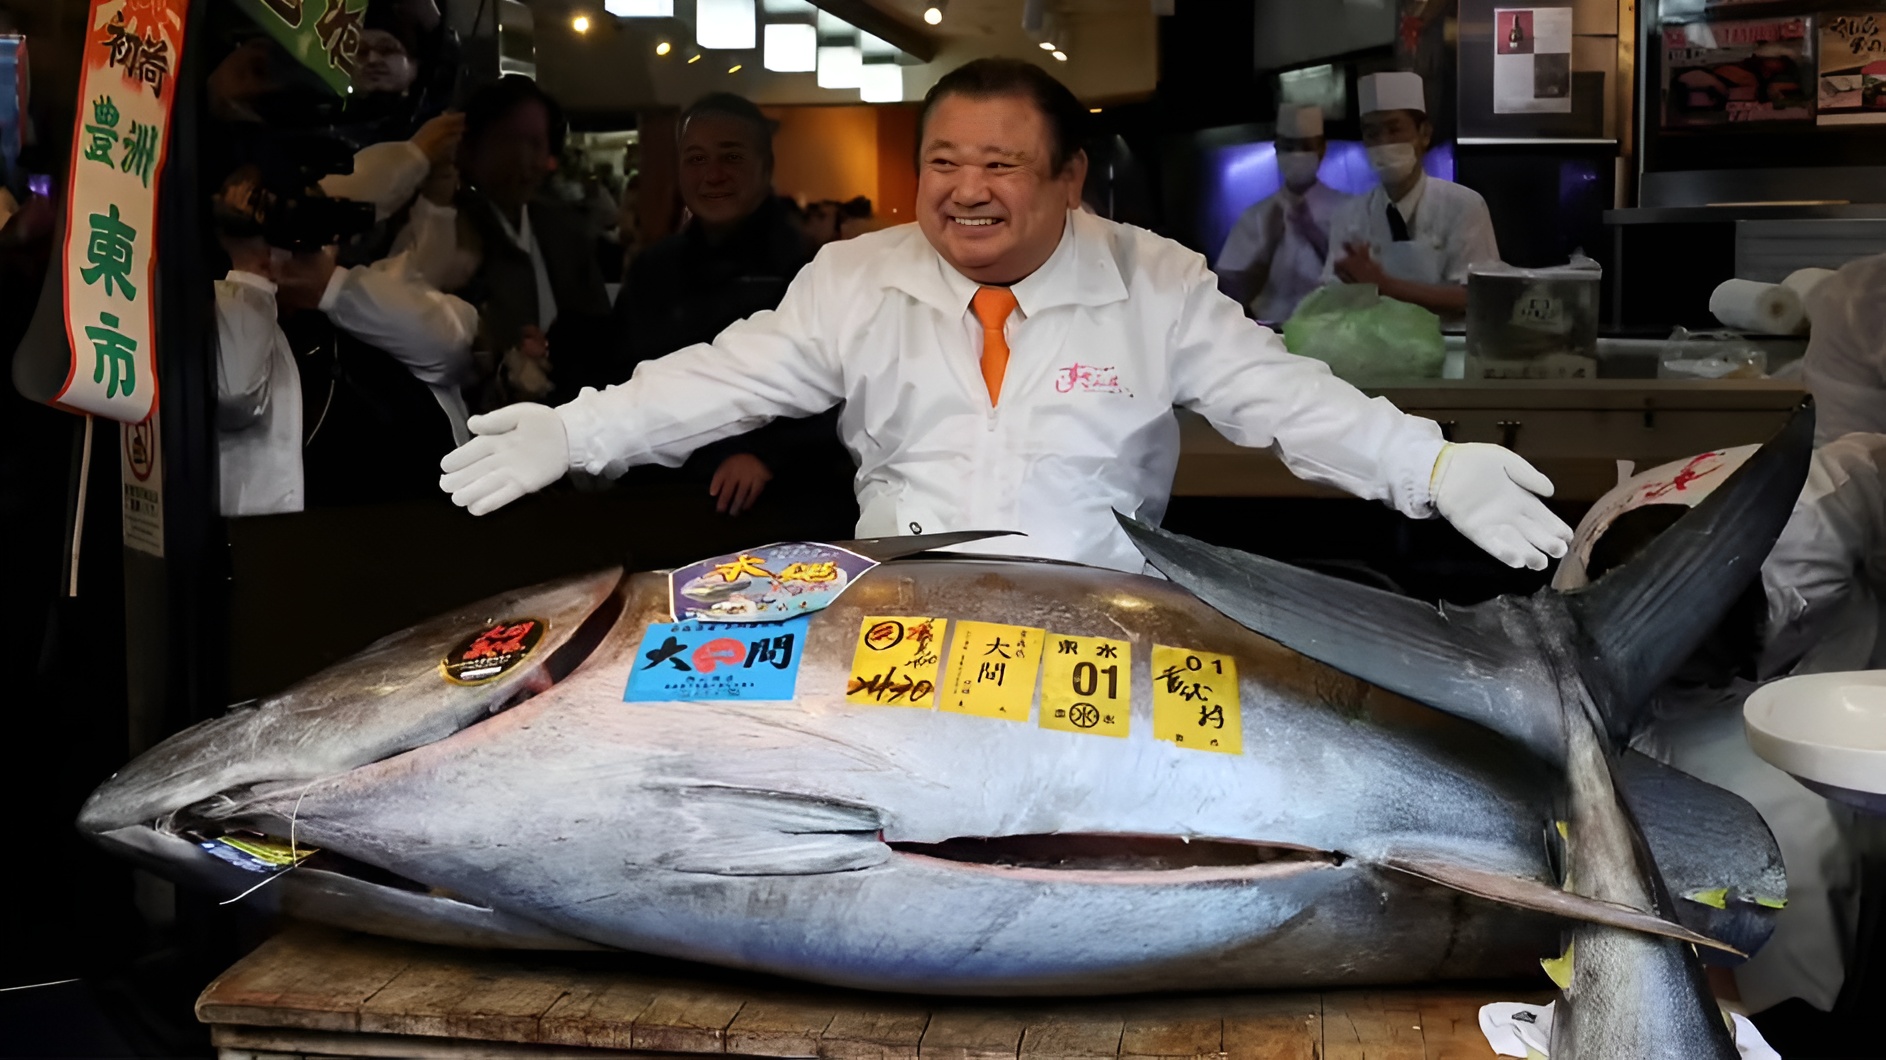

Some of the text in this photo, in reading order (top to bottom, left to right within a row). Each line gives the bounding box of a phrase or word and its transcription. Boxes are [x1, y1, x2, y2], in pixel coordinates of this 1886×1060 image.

[102, 10, 169, 99] 初荷
[84, 95, 158, 189] 豊洲
[80, 204, 137, 399] 東市
[1072, 661, 1118, 699] 01
[1186, 655, 1222, 675] 01
